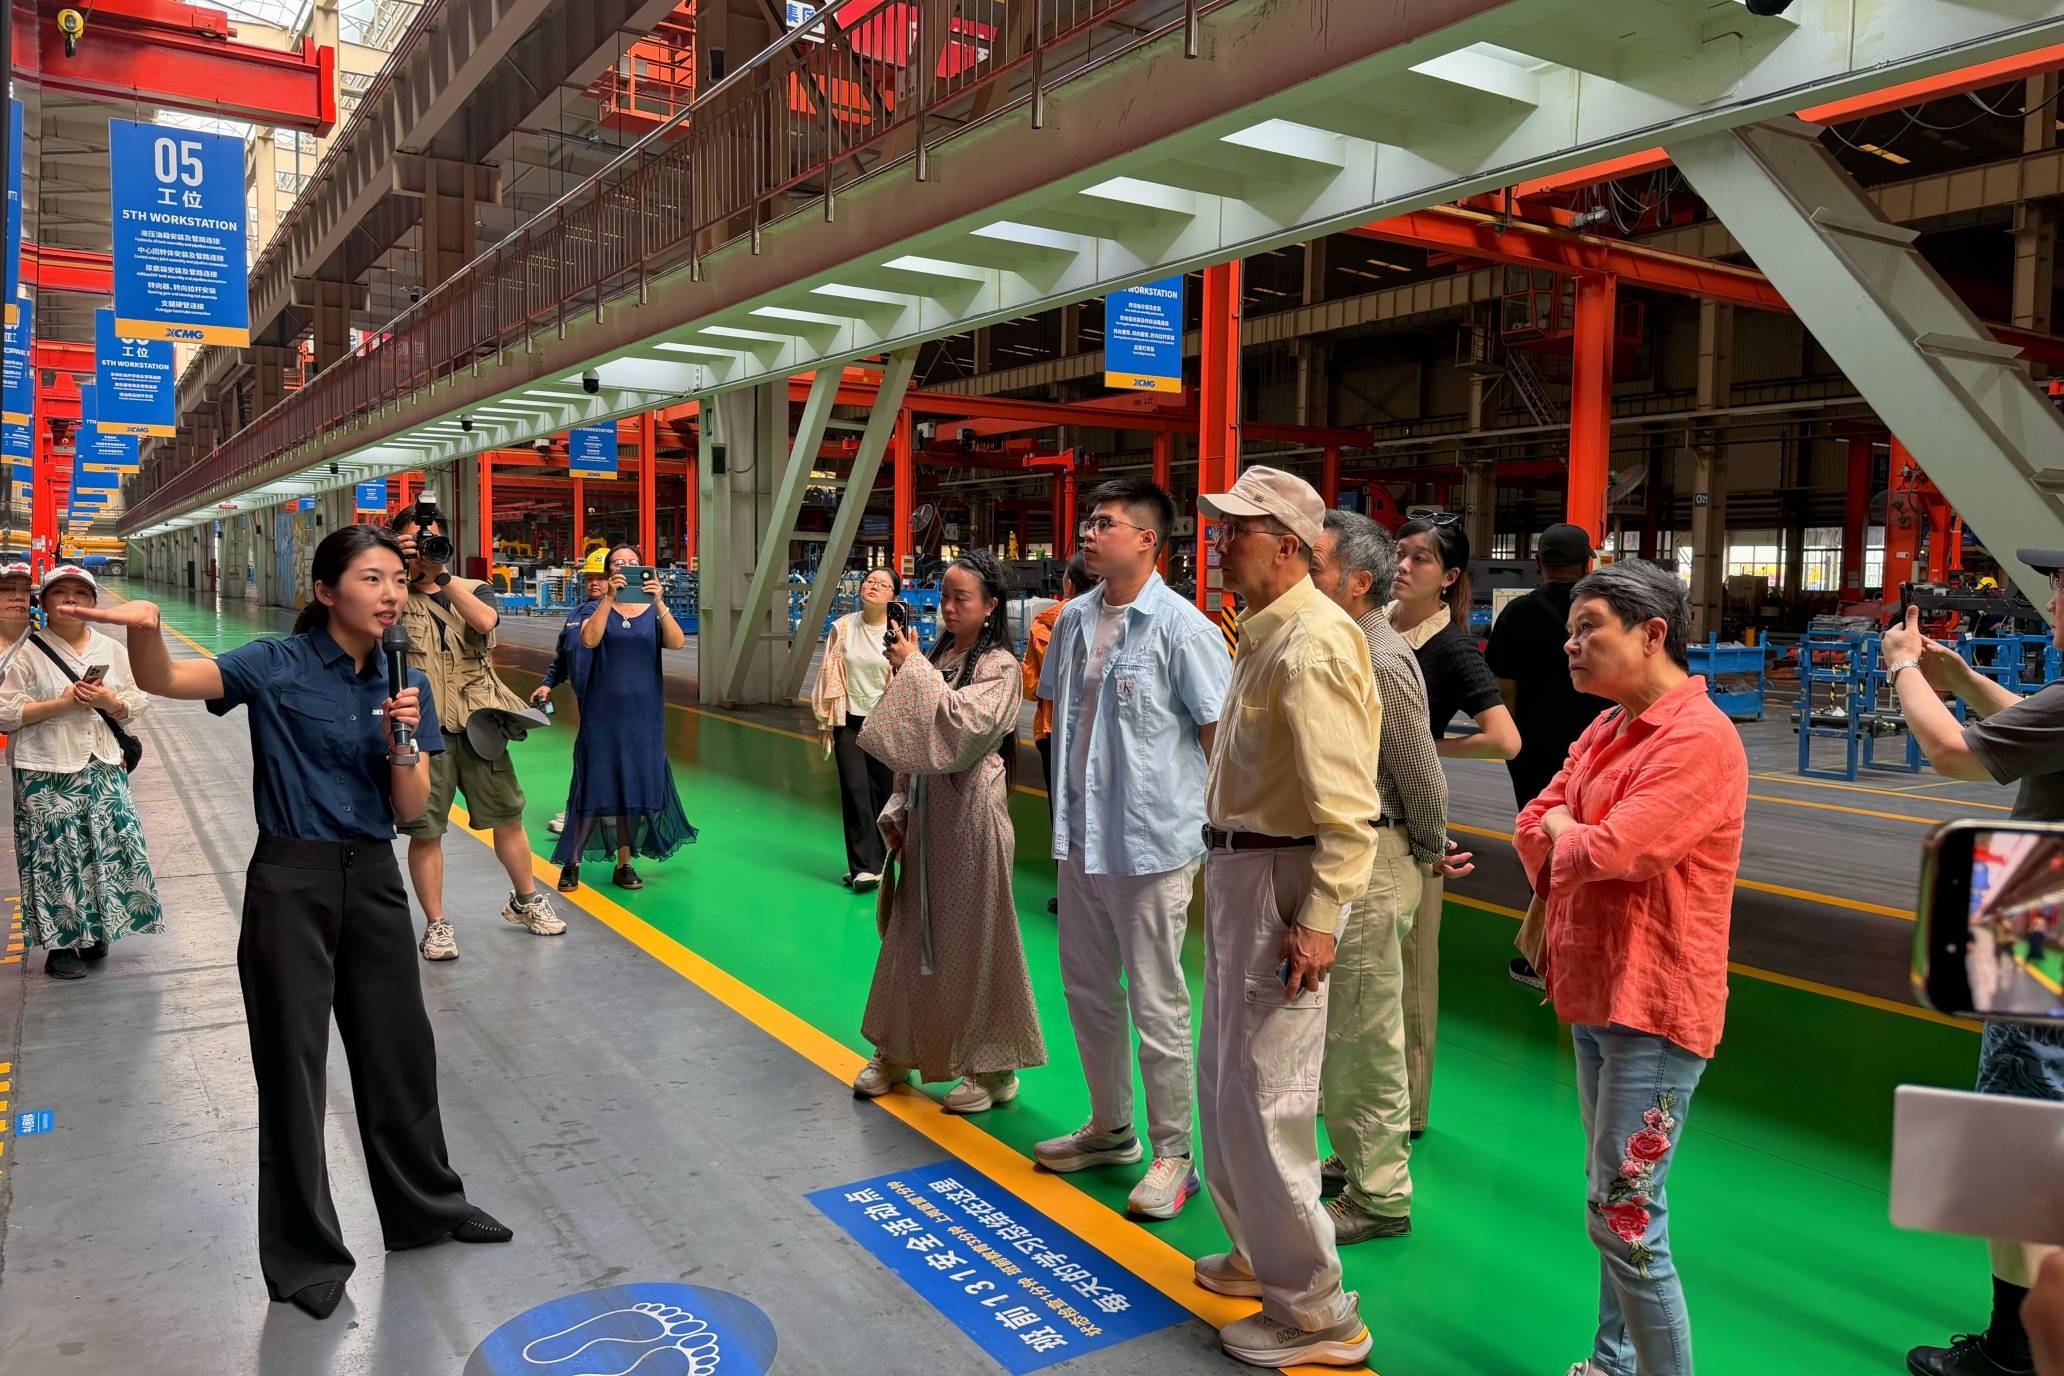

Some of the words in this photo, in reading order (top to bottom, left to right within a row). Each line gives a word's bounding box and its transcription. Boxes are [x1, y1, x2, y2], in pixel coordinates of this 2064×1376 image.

[154, 137, 204, 187] 05
[157, 187, 203, 209] 工位
[122, 209, 148, 222] 5TH
[150, 212, 238, 231] WORKSTATION
[1128, 286, 1178, 299] WORKSTATION
[165, 327, 204, 340] XCMG
[122, 346, 149, 358] 工位
[101, 359, 116, 367] 6TH
[118, 360, 170, 370] WORKSTATION
[1133, 379, 1156, 388] XCMG
[928, 1176, 1128, 1313] 每天的学习总结在这里
[845, 1187, 1068, 1353] 班前131安全活动点
[1018, 1275, 1103, 1337] 状态检查1分钟
